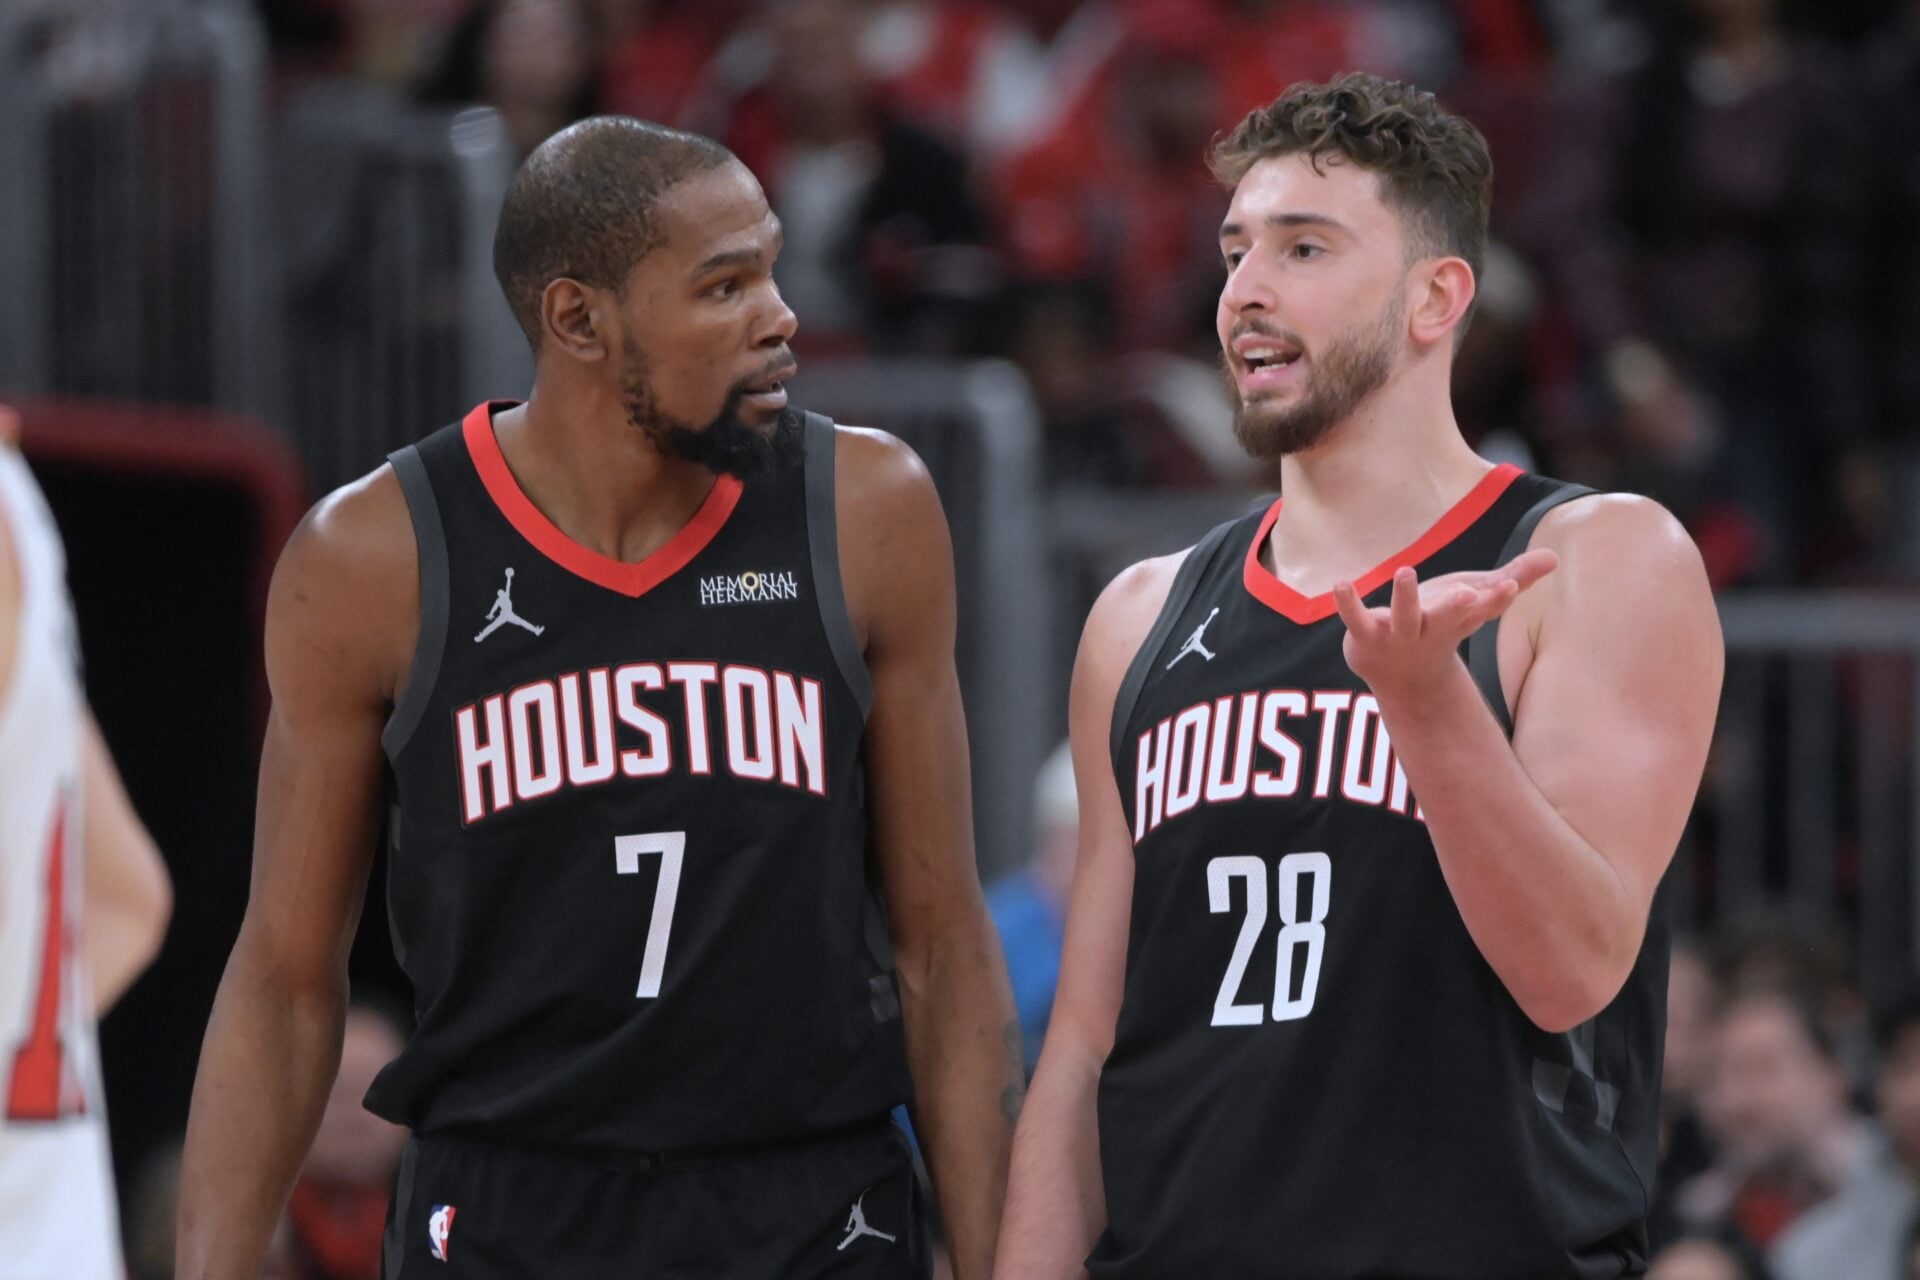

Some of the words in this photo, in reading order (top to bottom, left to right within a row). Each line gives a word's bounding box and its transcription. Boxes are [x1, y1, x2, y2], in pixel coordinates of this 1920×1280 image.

[700, 571, 797, 592] MEMORIAL
[700, 584, 797, 605] HERMANN
[455, 661, 826, 825] HOUSTON
[614, 831, 686, 998] 7
[1206, 851, 1332, 1026] 28
